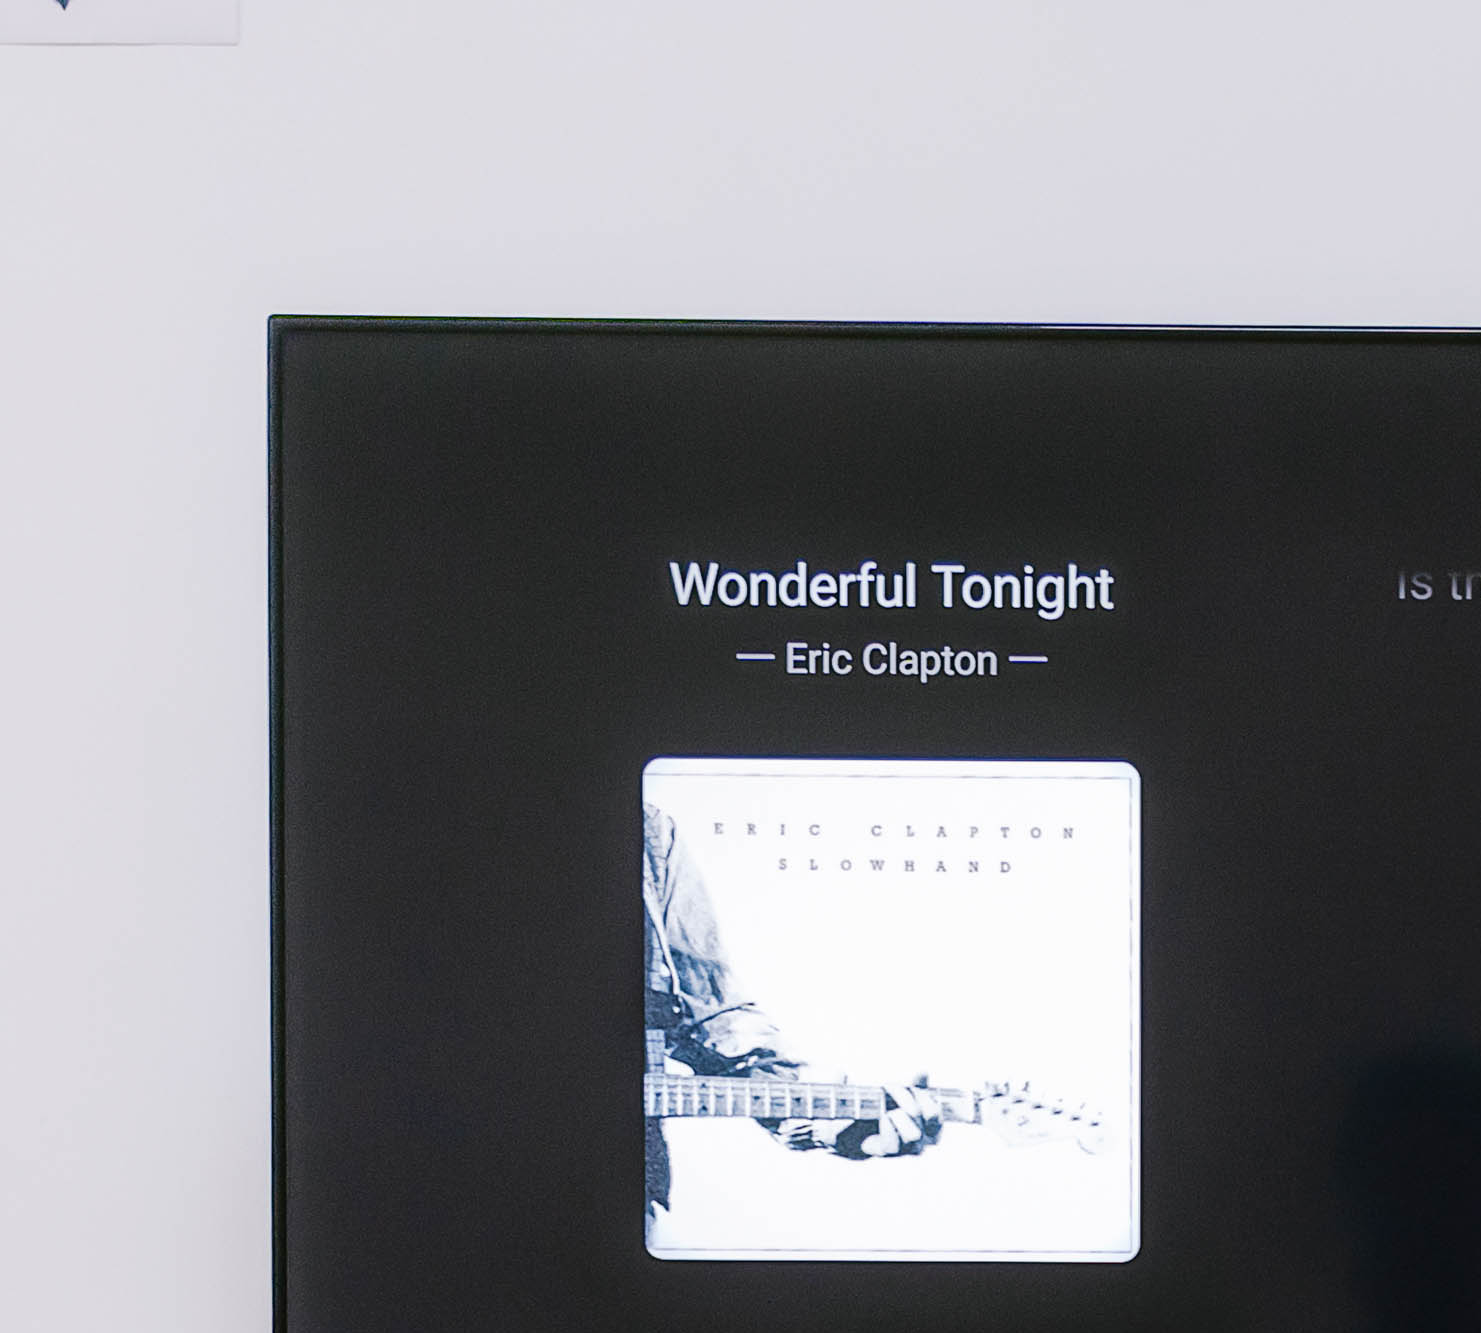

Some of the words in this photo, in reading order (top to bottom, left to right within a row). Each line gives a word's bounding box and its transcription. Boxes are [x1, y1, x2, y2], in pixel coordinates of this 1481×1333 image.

[669, 558, 917, 609] Wonderful
[930, 561, 1116, 621] Tonight
[785, 641, 853, 675] Eric
[862, 641, 999, 684] Clapton
[713, 822, 821, 837] ERIC
[870, 824, 1074, 839] CLAPTON
[777, 858, 1012, 873] SLOWHAND
